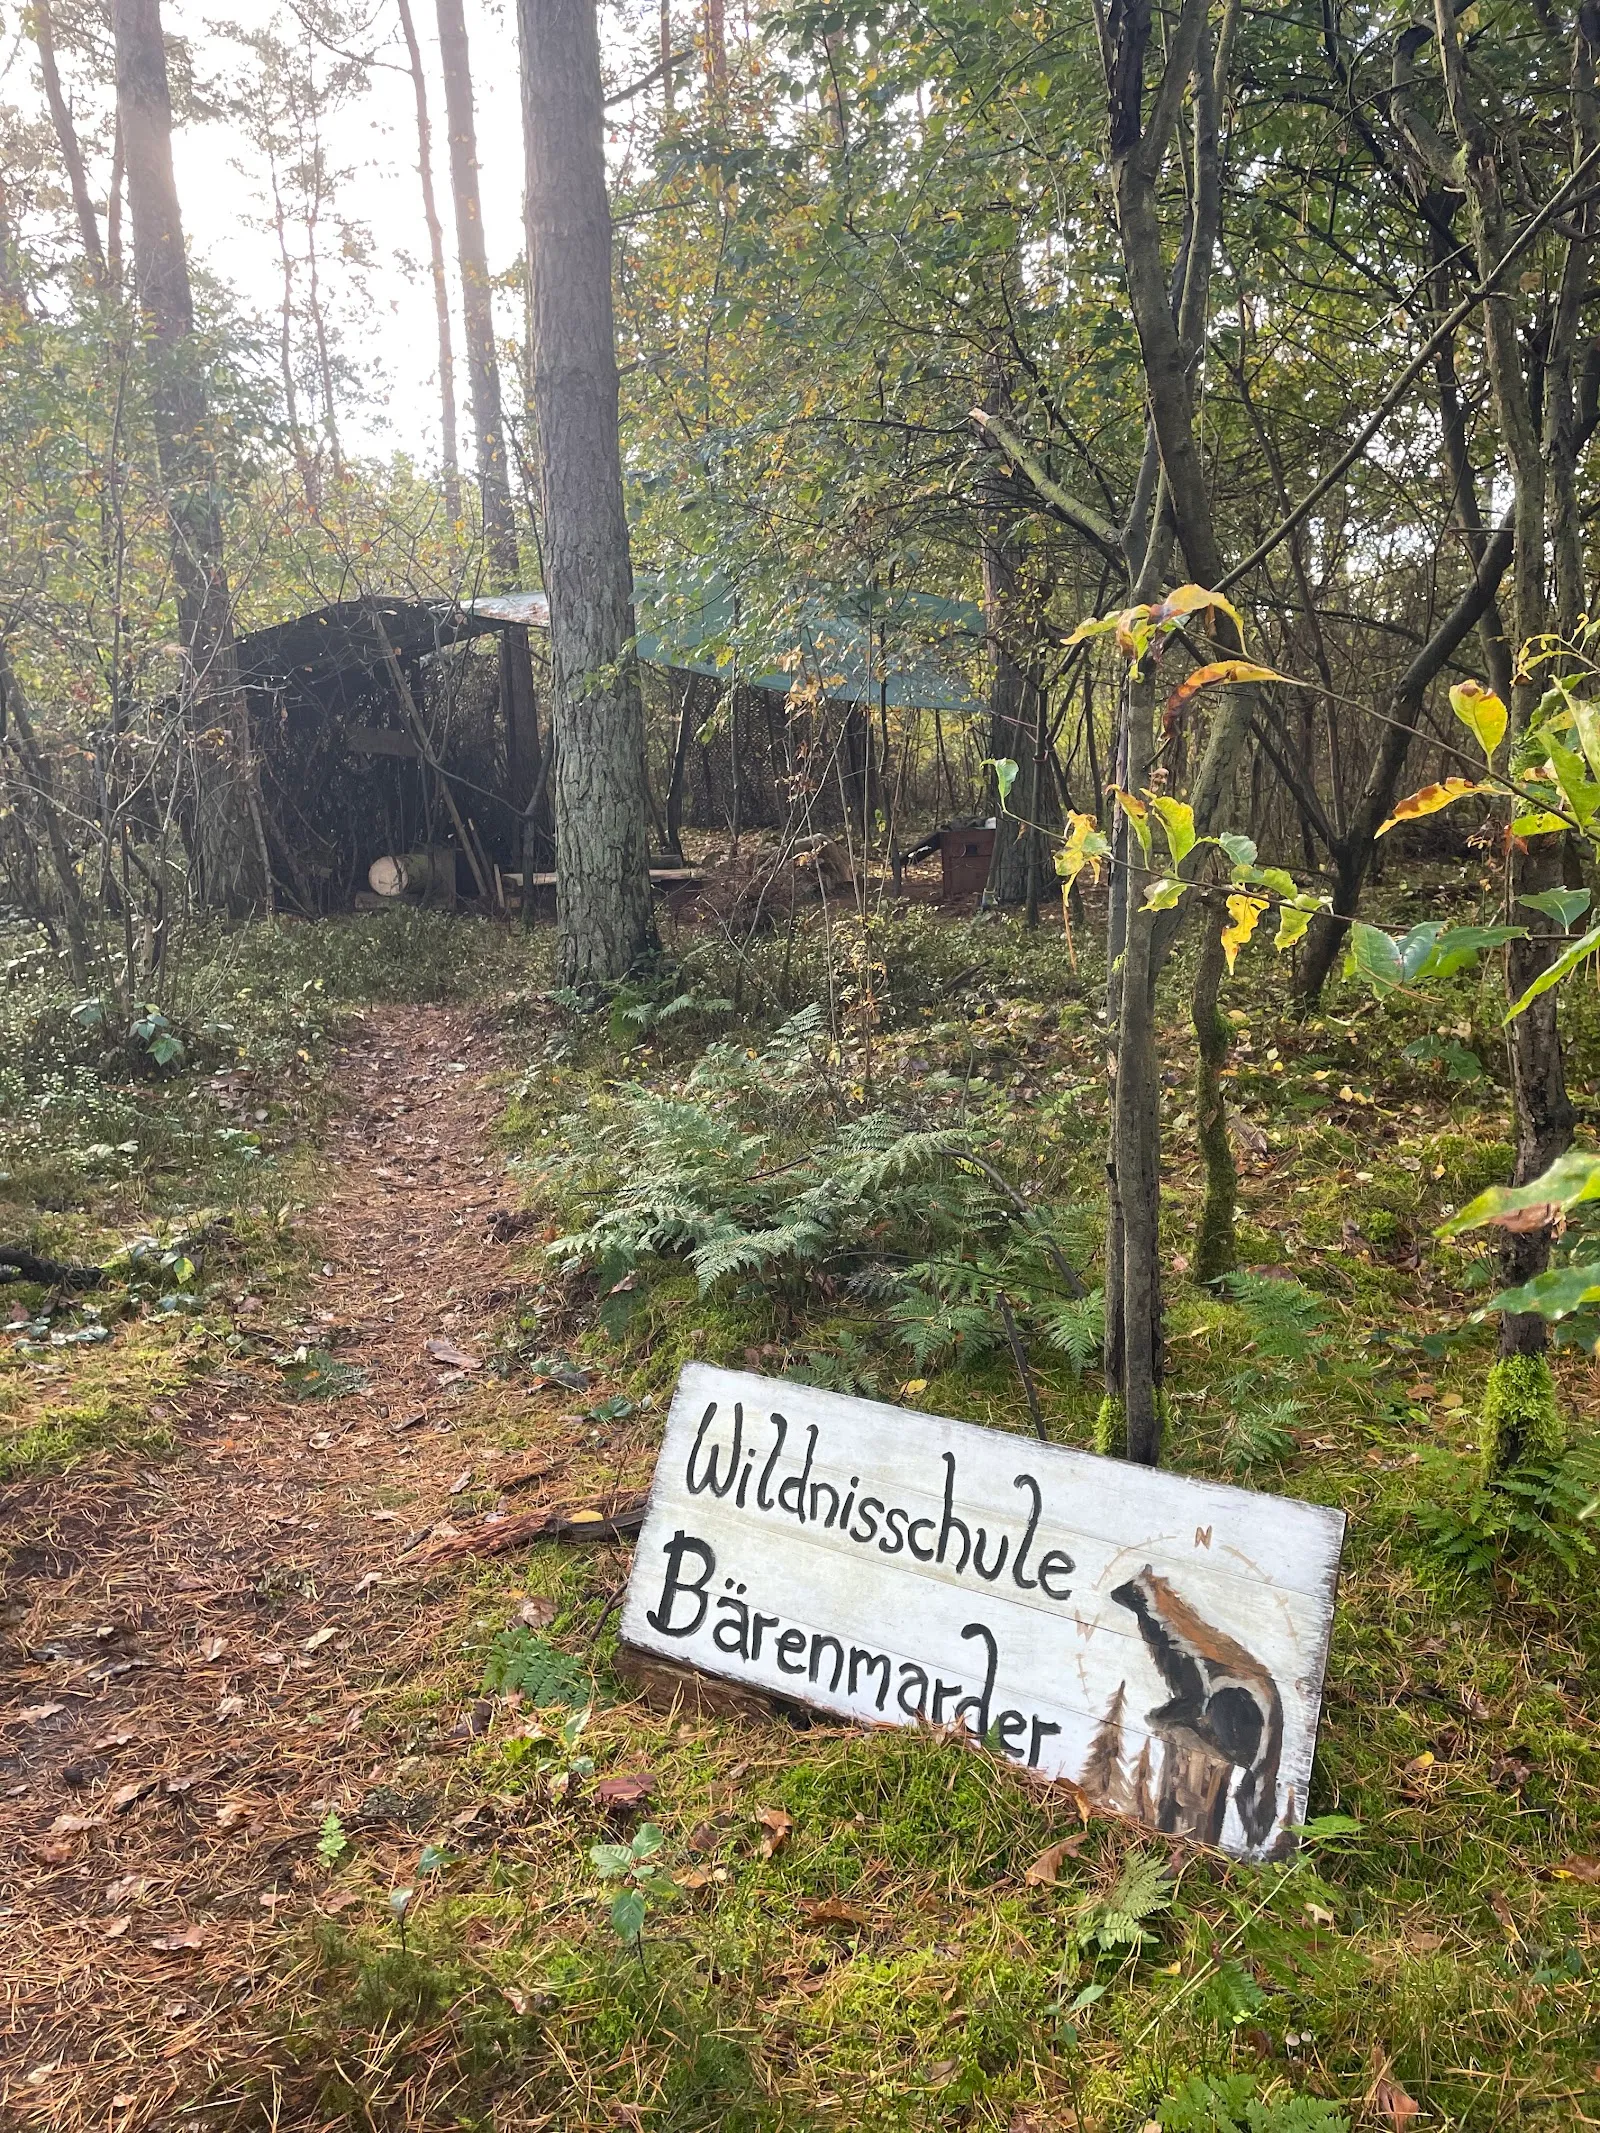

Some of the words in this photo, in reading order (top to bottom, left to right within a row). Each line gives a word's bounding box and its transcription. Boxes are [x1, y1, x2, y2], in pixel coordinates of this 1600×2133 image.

[687, 1402, 1076, 1600] Wildnisschule
[1194, 1525, 1213, 1549] N
[646, 1529, 1062, 1768] Bärenmarder
